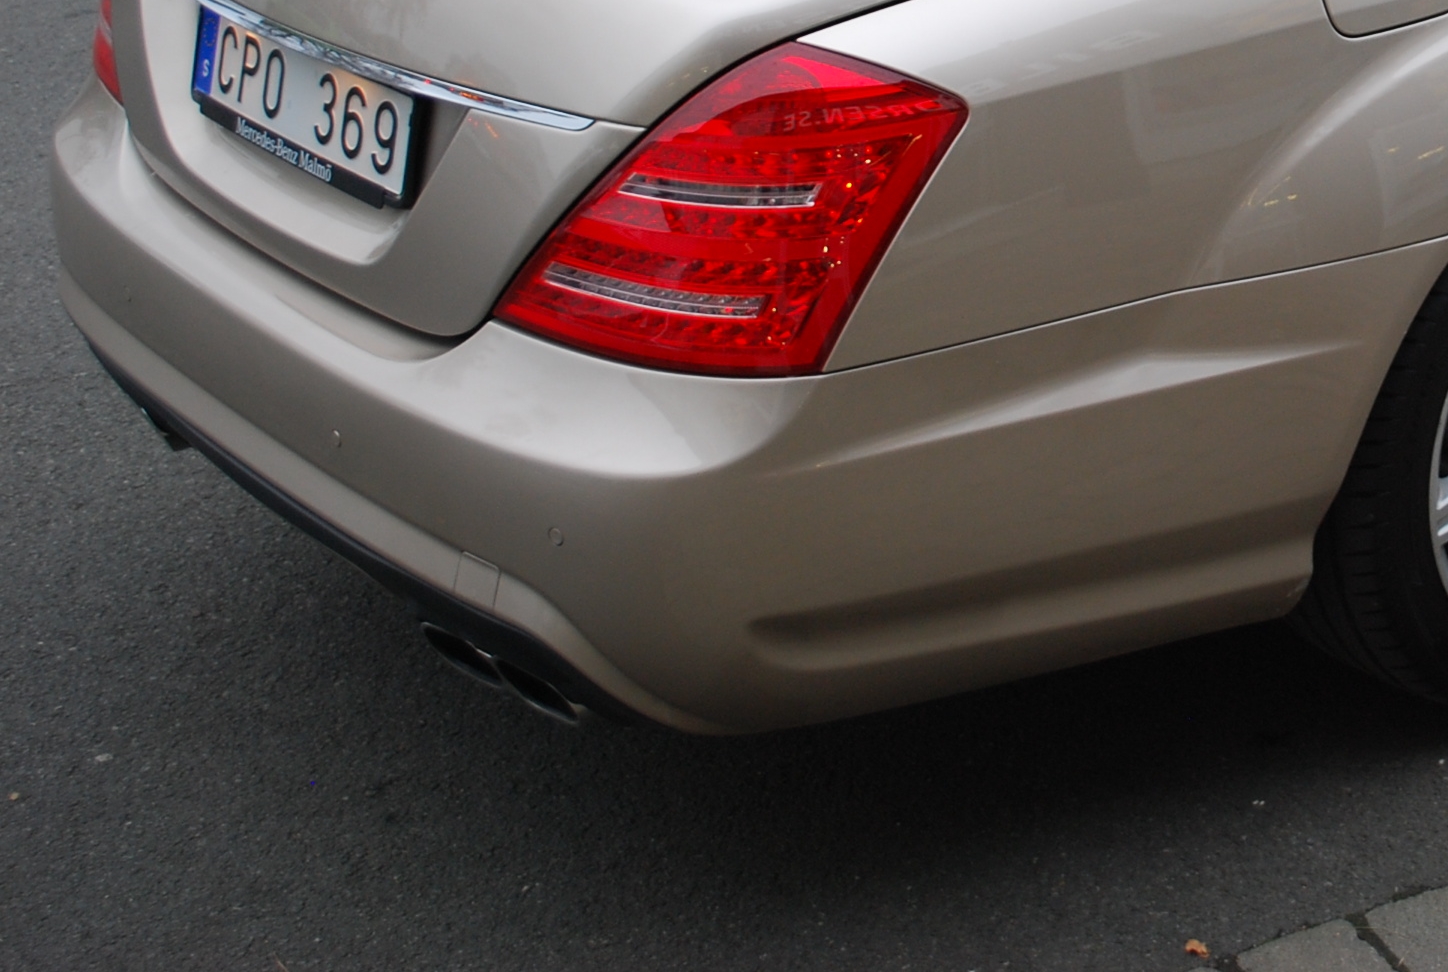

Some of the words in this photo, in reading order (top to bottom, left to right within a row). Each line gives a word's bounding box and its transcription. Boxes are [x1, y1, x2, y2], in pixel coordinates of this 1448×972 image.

[202, 59, 210, 78] S
[217, 26, 285, 119] CPO
[313, 73, 398, 175] 369
[235, 116, 299, 166] Mercedes-Benz
[298, 149, 332, 182] Malmö
